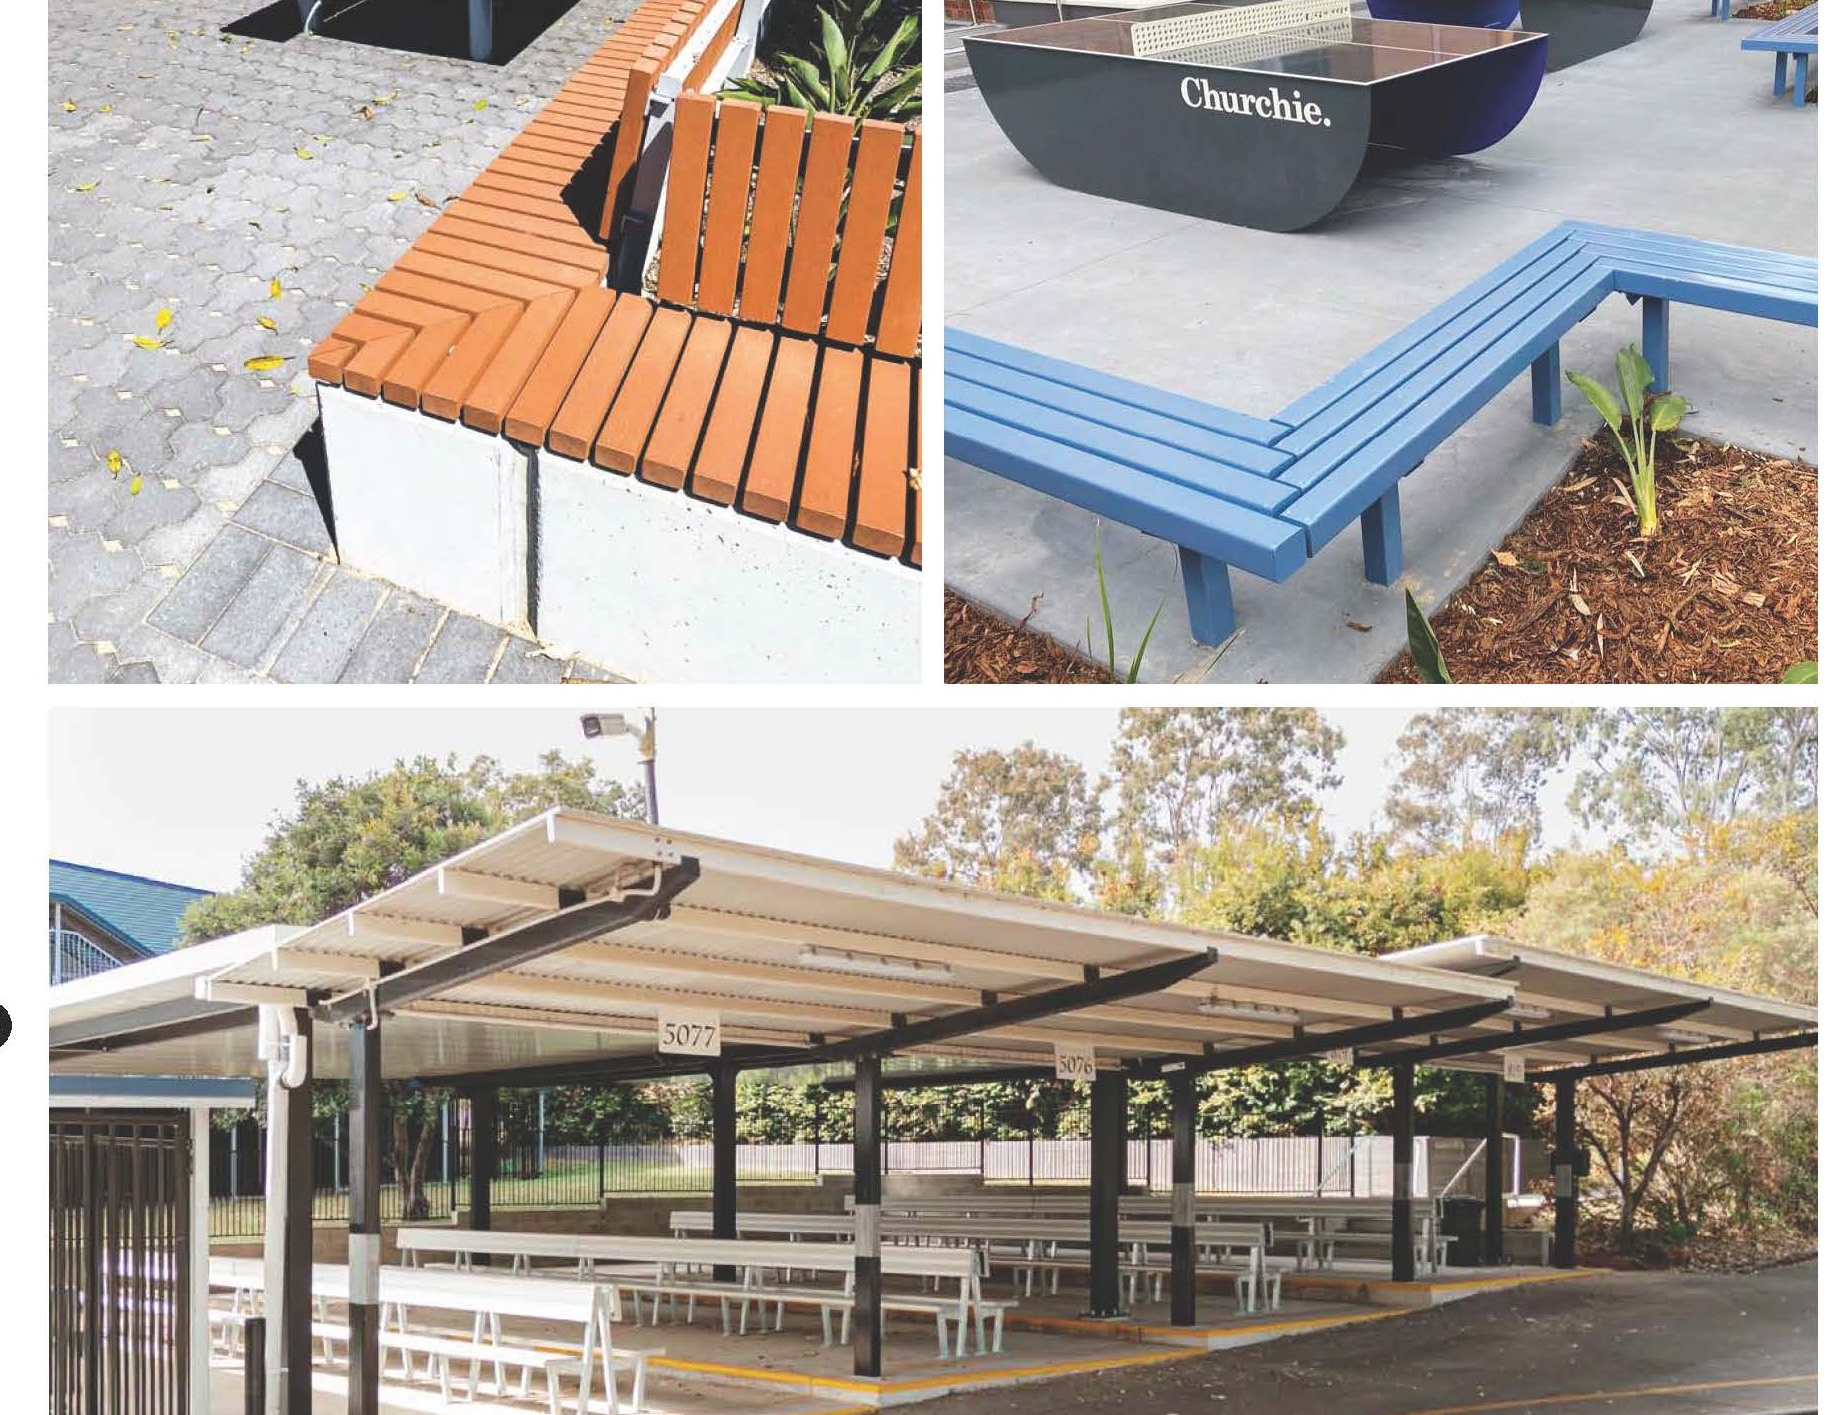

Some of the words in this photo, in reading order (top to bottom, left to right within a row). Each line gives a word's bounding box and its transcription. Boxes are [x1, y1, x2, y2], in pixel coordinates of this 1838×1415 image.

[1180, 76, 1331, 127] Churchie.
[663, 1022, 716, 1048] 5077
[1059, 1055, 1092, 1075] 5076
